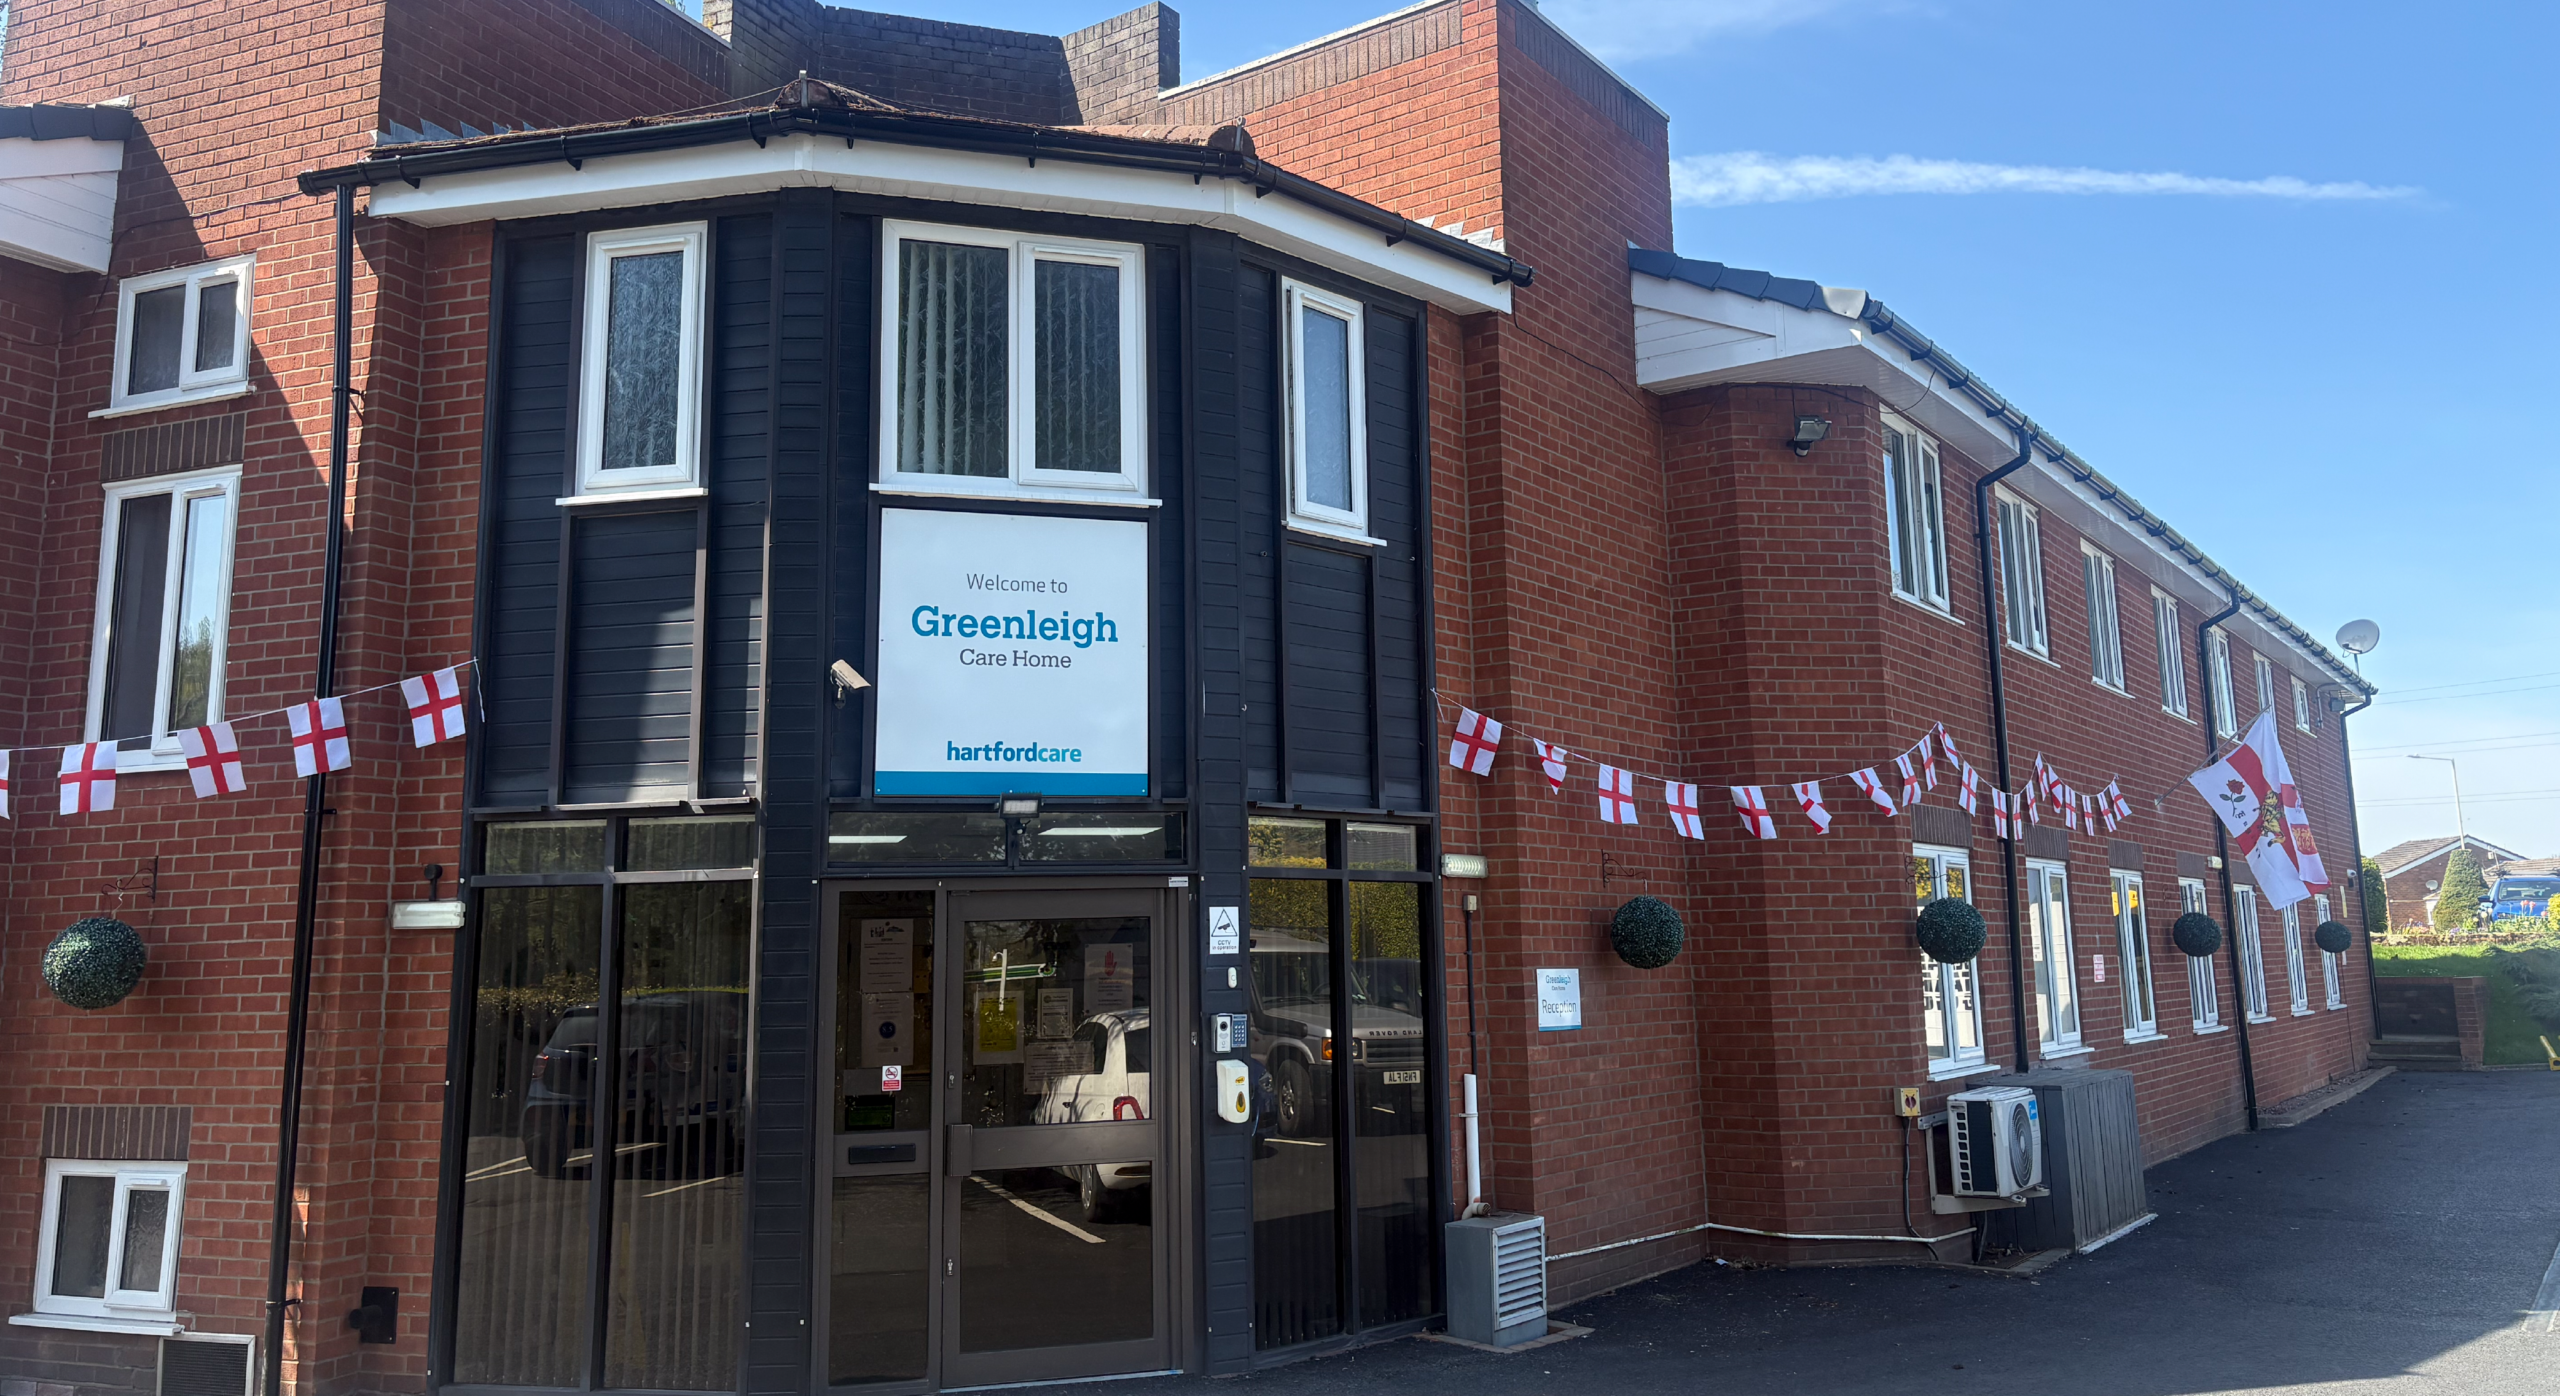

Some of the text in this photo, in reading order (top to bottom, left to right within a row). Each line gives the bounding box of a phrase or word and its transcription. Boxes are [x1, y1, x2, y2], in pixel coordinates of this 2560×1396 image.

[966, 573, 1068, 594] Welcome to
[911, 605, 1119, 649] Greenleigh
[959, 649, 1072, 669] Care Home
[946, 740, 1082, 763] hartfordcare
[1545, 975, 1571, 985] Greenleigh
[1542, 999, 1576, 1017] Reception
